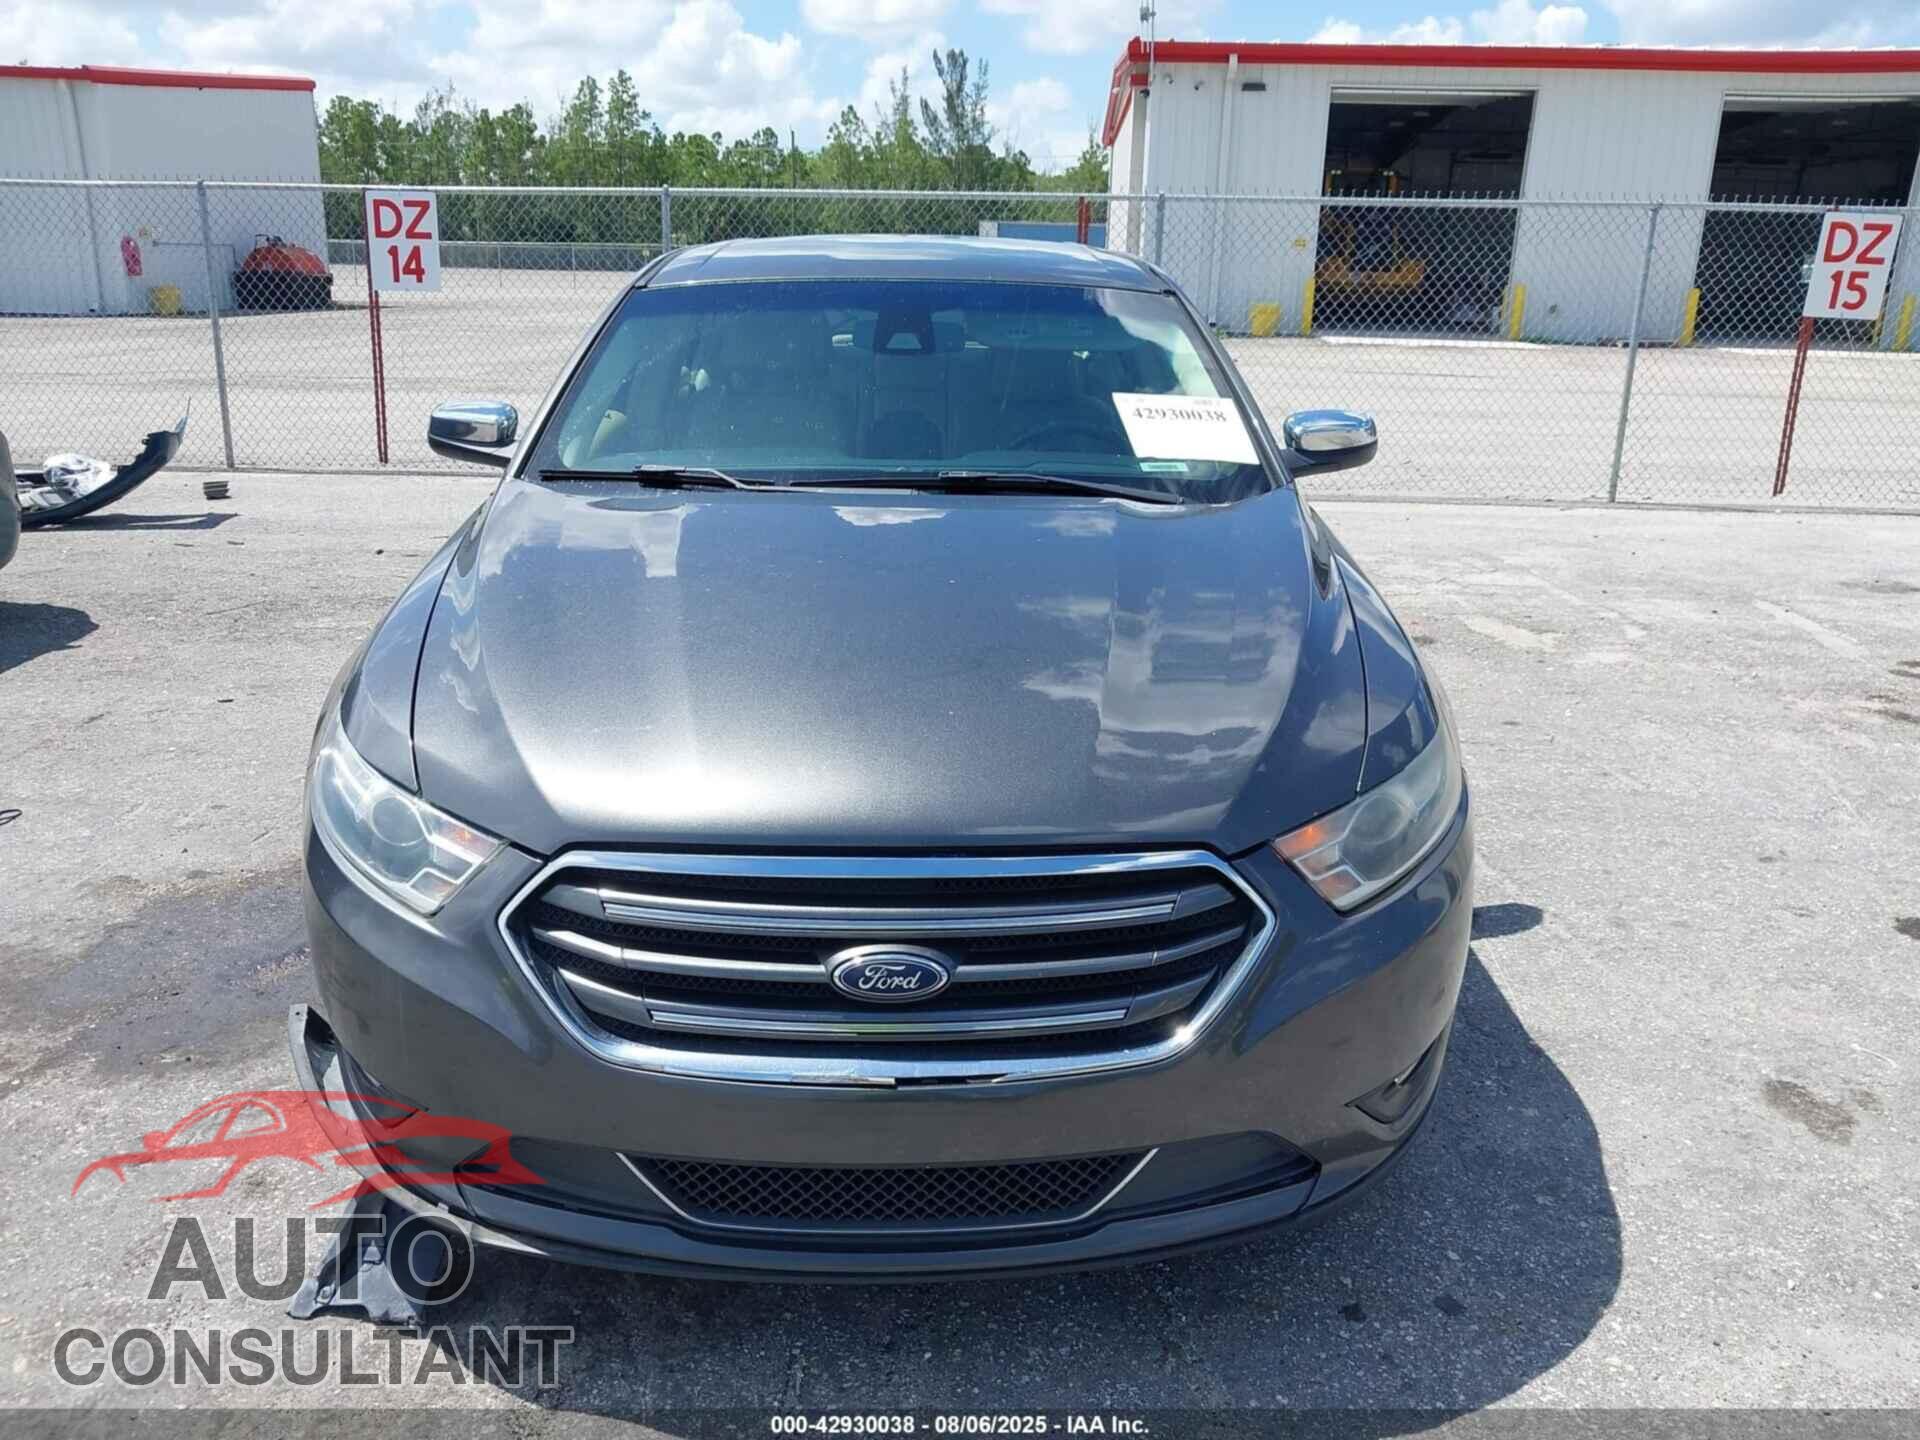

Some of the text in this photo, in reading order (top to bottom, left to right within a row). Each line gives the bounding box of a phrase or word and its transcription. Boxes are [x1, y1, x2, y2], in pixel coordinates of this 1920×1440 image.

[373, 198, 433, 240] DZ
[1823, 221, 1894, 265] DZ
[387, 245, 426, 283] 14
[1828, 270, 1870, 311] 15
[1132, 406, 1227, 422] 42930038
[858, 964, 922, 989] Ford
